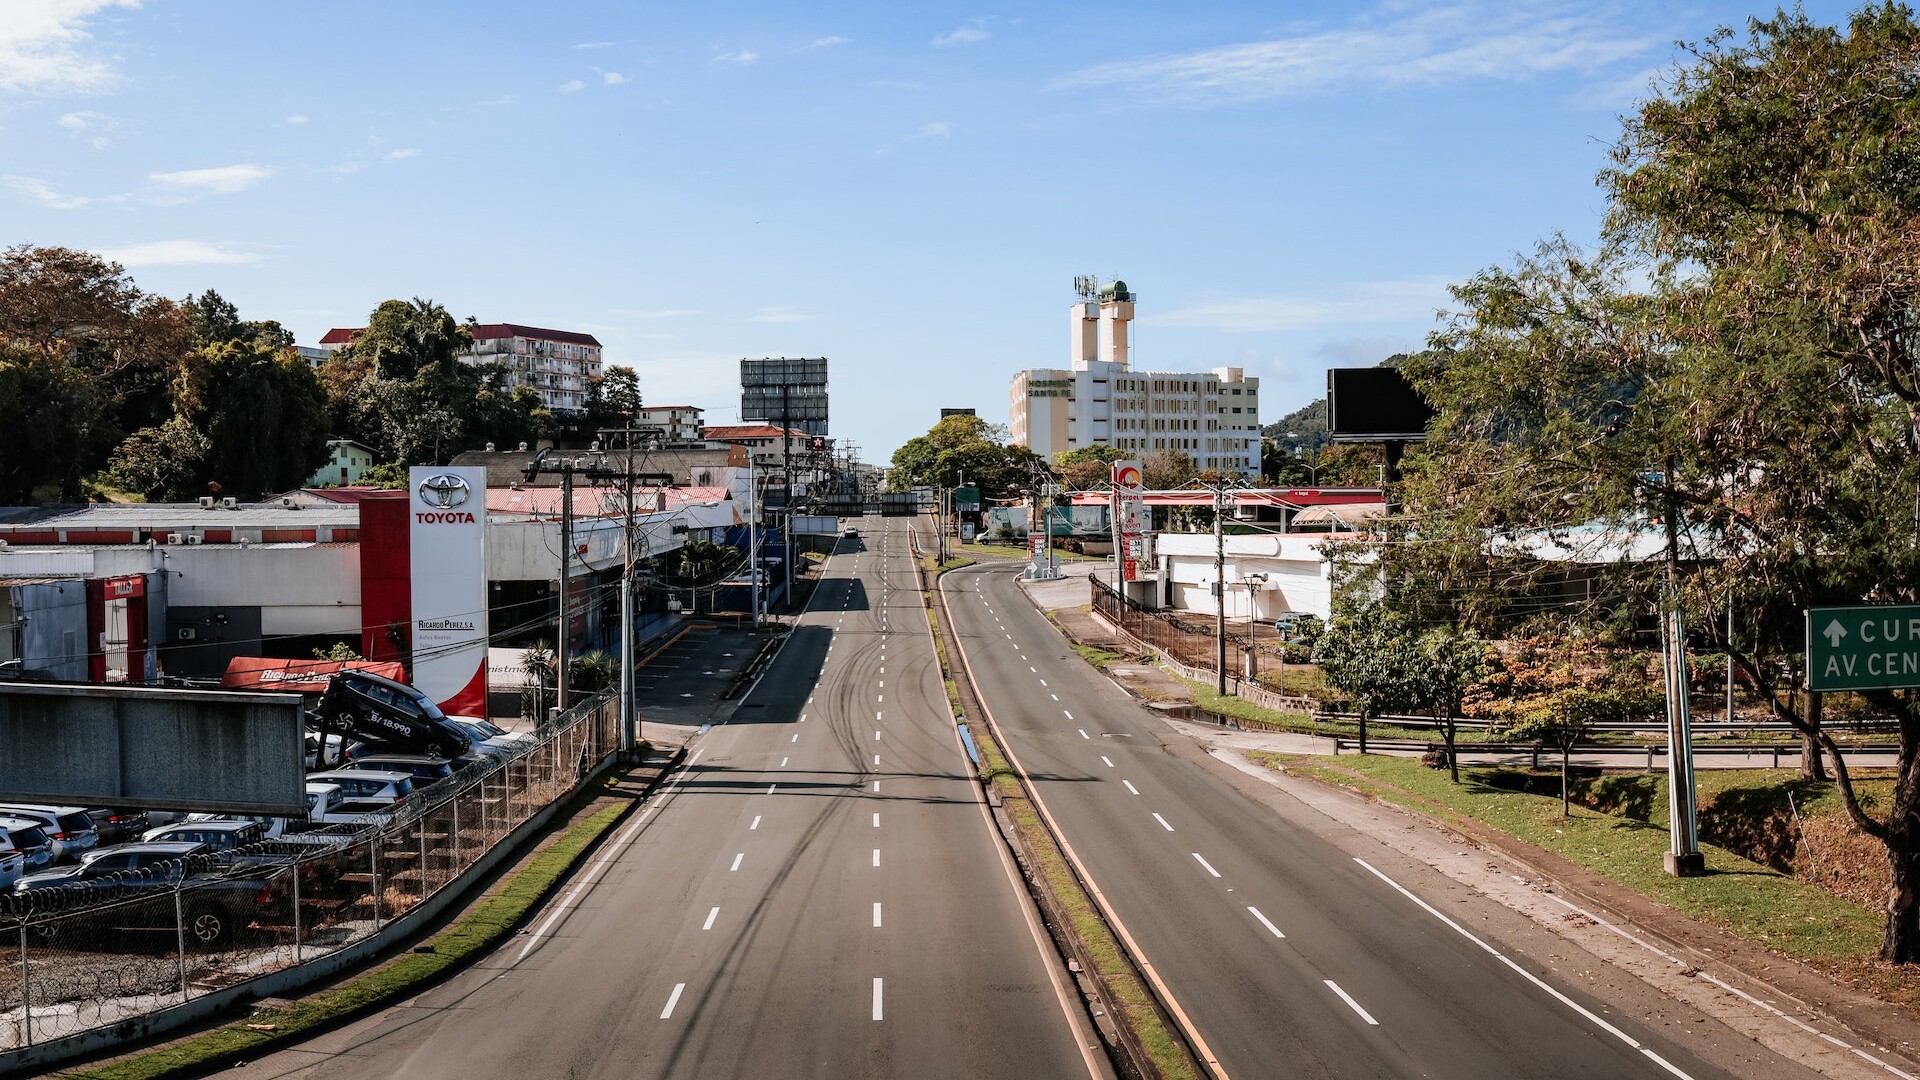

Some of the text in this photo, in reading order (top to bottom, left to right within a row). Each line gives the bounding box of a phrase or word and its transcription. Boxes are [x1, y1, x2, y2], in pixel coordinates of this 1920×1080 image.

[1028, 389, 1058, 397] SANTA
[416, 512, 475, 524] TOYOTA
[418, 620, 444, 629] RICARDO
[1860, 619, 1920, 642] CUR
[1824, 652, 1918, 678] AV. CEN
[371, 714, 411, 734] B/ 18.990
